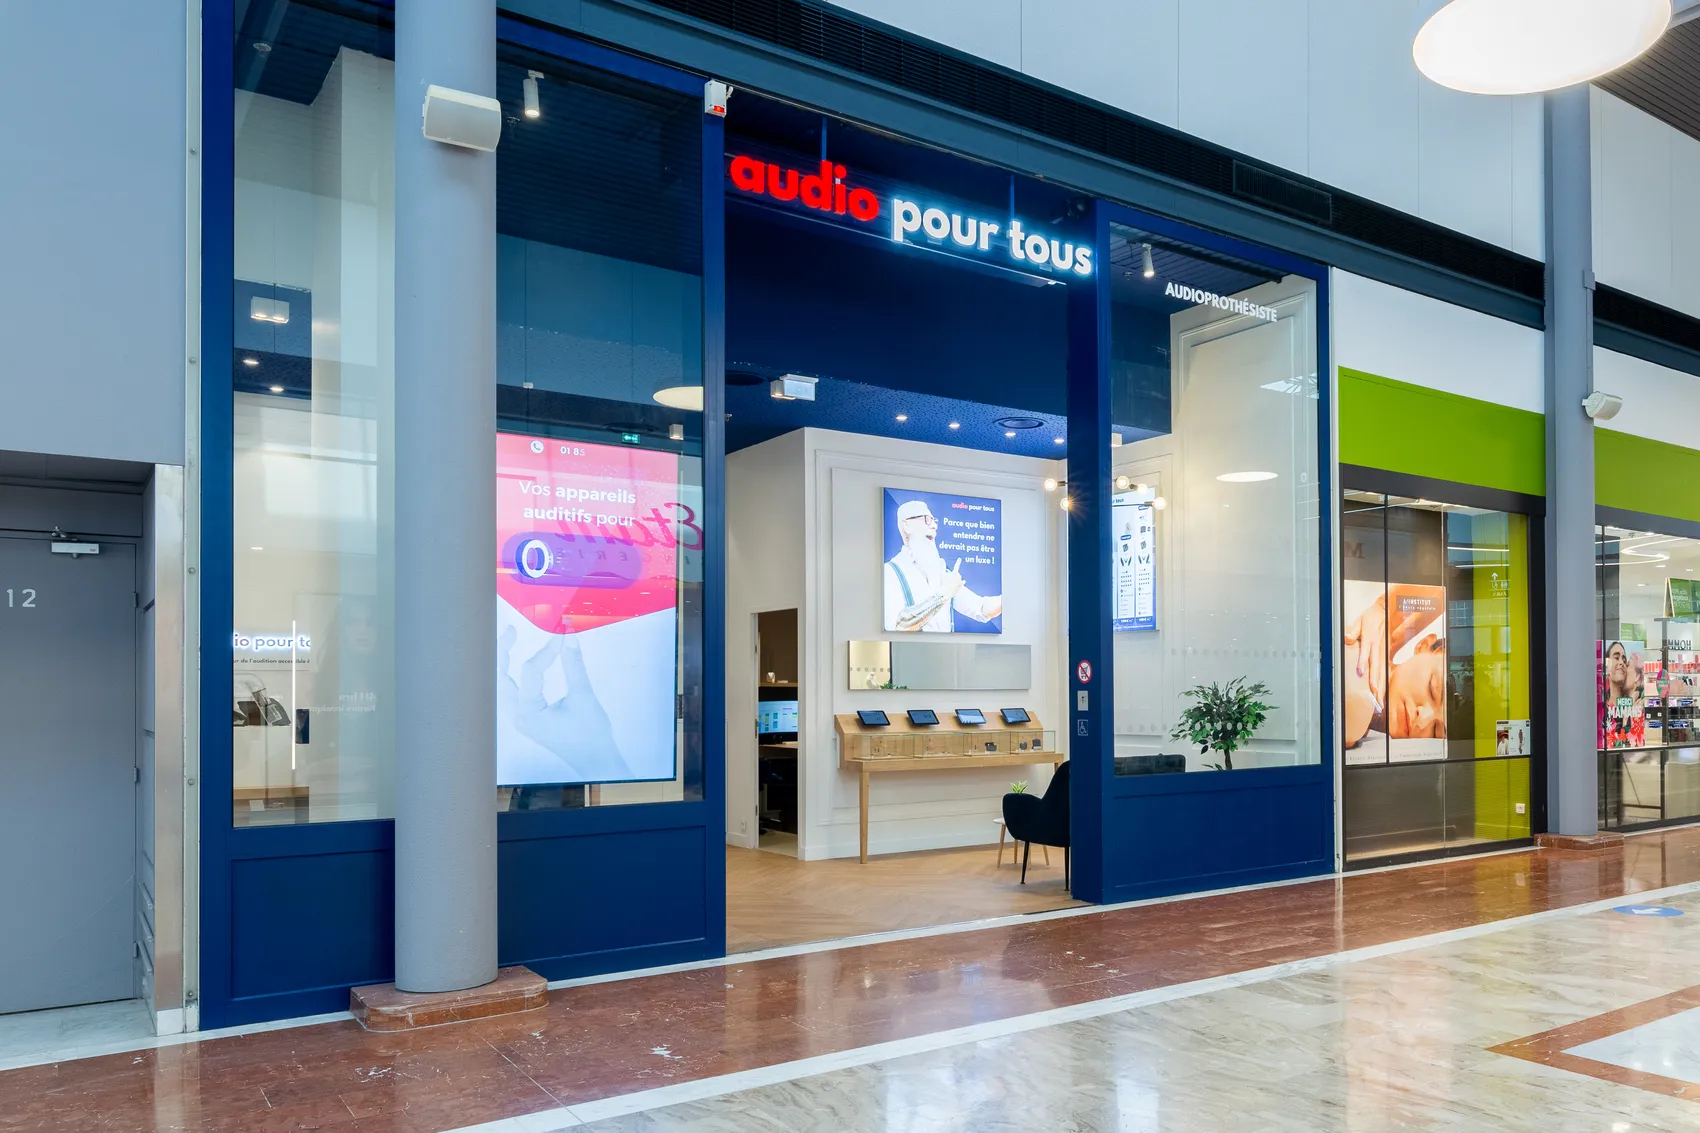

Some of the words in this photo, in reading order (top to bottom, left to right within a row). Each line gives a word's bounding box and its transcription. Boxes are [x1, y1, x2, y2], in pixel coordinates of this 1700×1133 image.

[730, 155, 880, 222] audio
[891, 198, 1000, 250] pour
[1008, 219, 1093, 275] tous
[1165, 281, 1278, 322] AUDIOPROTHÉSISTE
[519, 480, 551, 497] Vos
[555, 485, 636, 504] appareils
[523, 506, 593, 524] auditifs
[596, 513, 635, 527] pour
[943, 517, 964, 527] Parce
[965, 521, 978, 530] que
[980, 520, 995, 530] bien
[953, 532, 985, 541] entendre
[939, 540, 965, 551] devrait
[966, 545, 980, 553] pas
[981, 544, 995, 553] être
[976, 555, 990, 564] luxe
[7, 588, 36, 608] 12
[255, 638, 293, 650] pour
[1607, 705, 1642, 719] MAMANS
